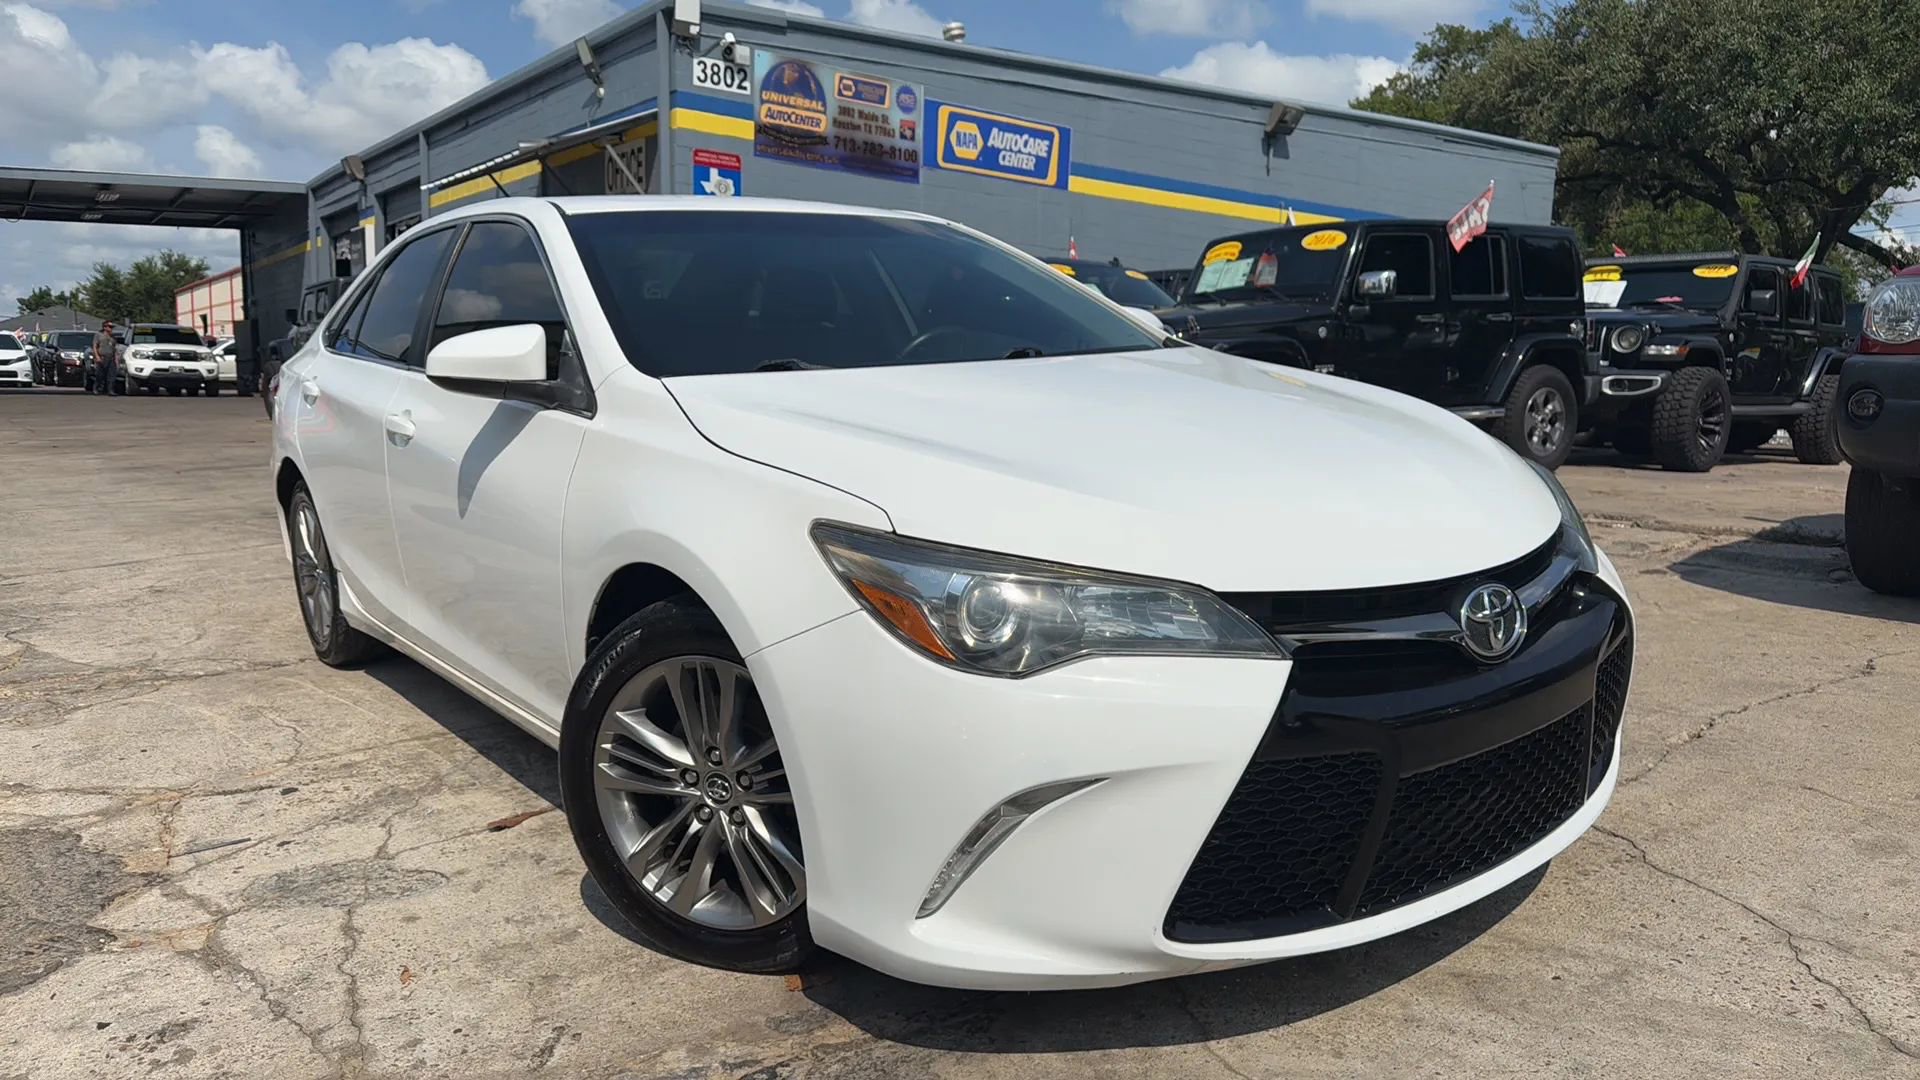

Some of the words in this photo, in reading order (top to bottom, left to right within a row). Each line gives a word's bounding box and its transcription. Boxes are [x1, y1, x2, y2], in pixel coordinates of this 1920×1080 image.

[697, 60, 748, 90] 3802
[762, 91, 825, 111] UNIVERSAL
[956, 131, 978, 149] NAPA
[998, 152, 1036, 171] CENTER
